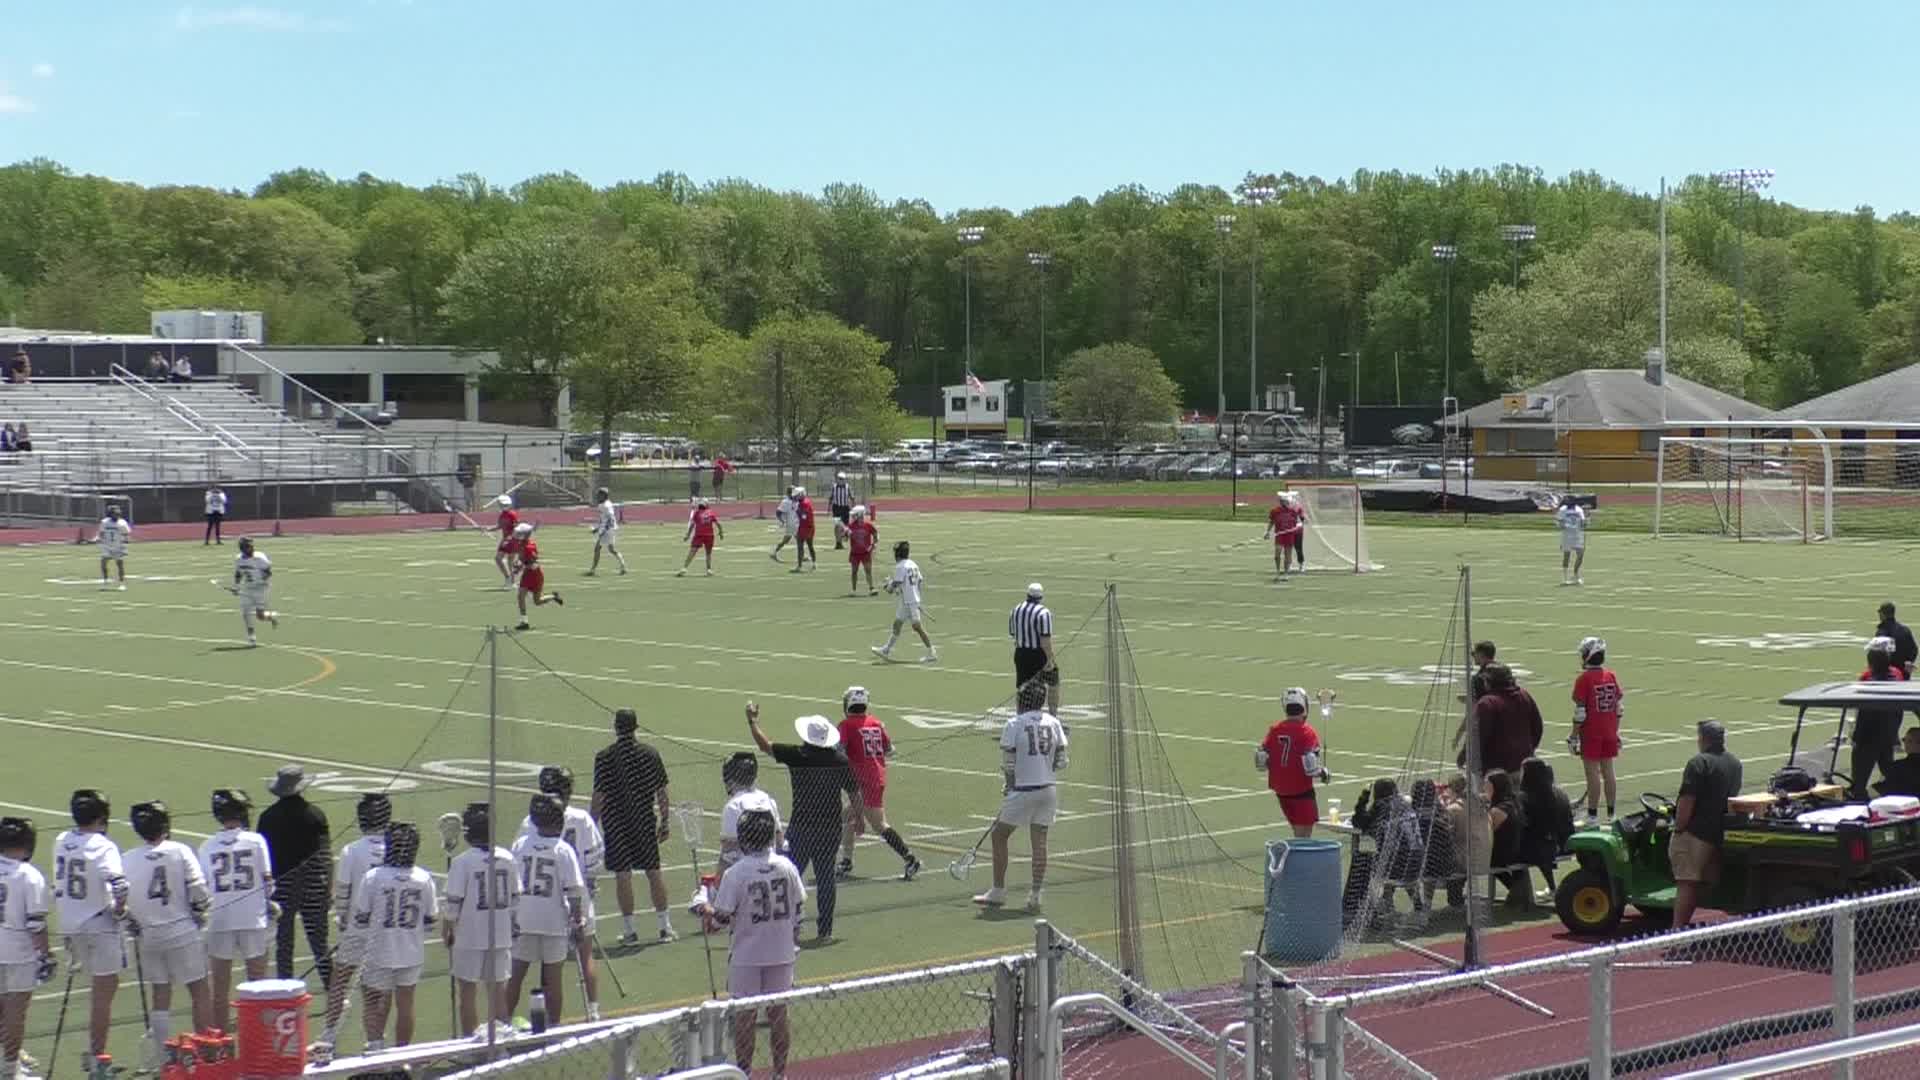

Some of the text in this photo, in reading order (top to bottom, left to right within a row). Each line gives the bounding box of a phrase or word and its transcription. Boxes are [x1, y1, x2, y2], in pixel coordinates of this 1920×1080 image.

[1277, 735, 1291, 768] 7
[147, 865, 170, 907] 4
[210, 848, 254, 893] 25
[474, 869, 509, 911] 10
[522, 855, 555, 898] 15
[382, 887, 422, 930] 16
[748, 877, 790, 925] 33
